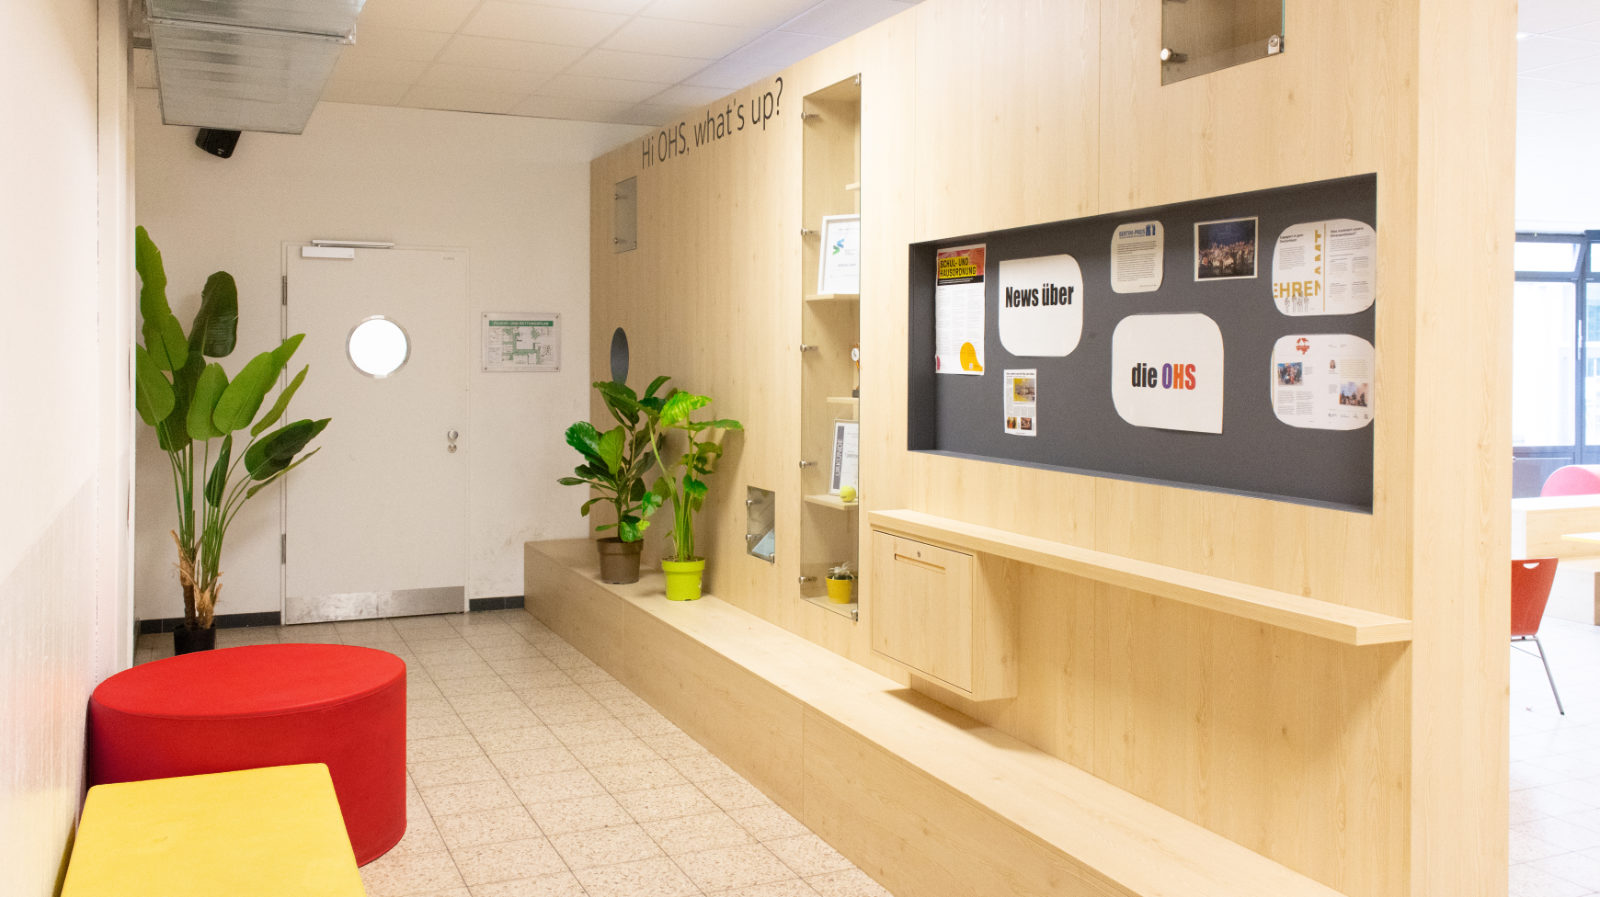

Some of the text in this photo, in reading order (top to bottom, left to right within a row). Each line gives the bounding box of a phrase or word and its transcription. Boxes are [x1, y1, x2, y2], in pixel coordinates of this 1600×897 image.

[642, 76, 784, 169] Hi OHS, what's up?
[1005, 283, 1074, 308] News über
[1131, 362, 1197, 391] die OHS
